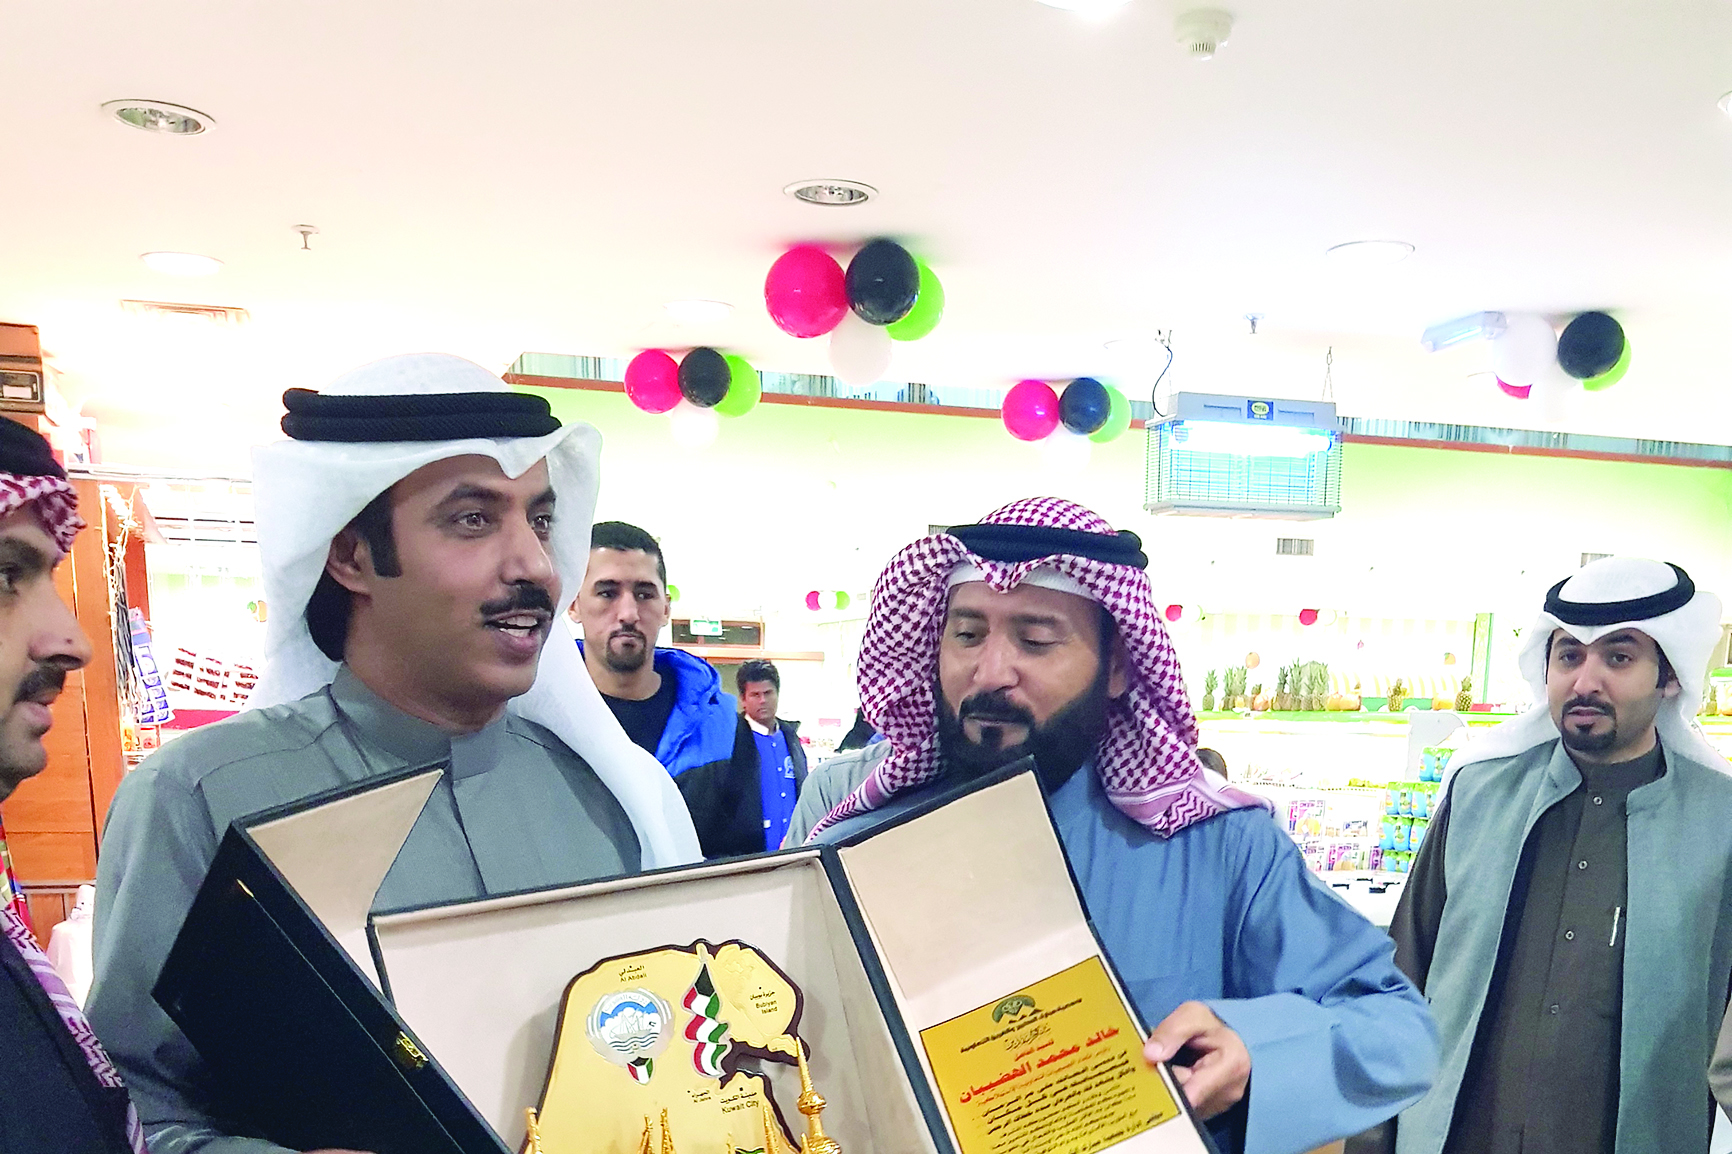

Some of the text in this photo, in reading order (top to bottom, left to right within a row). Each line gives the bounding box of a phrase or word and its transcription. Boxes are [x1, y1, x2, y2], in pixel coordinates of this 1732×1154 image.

[1036, 1044, 1080, 1068] محمد
[721, 1100, 760, 1115] Kuwait City
